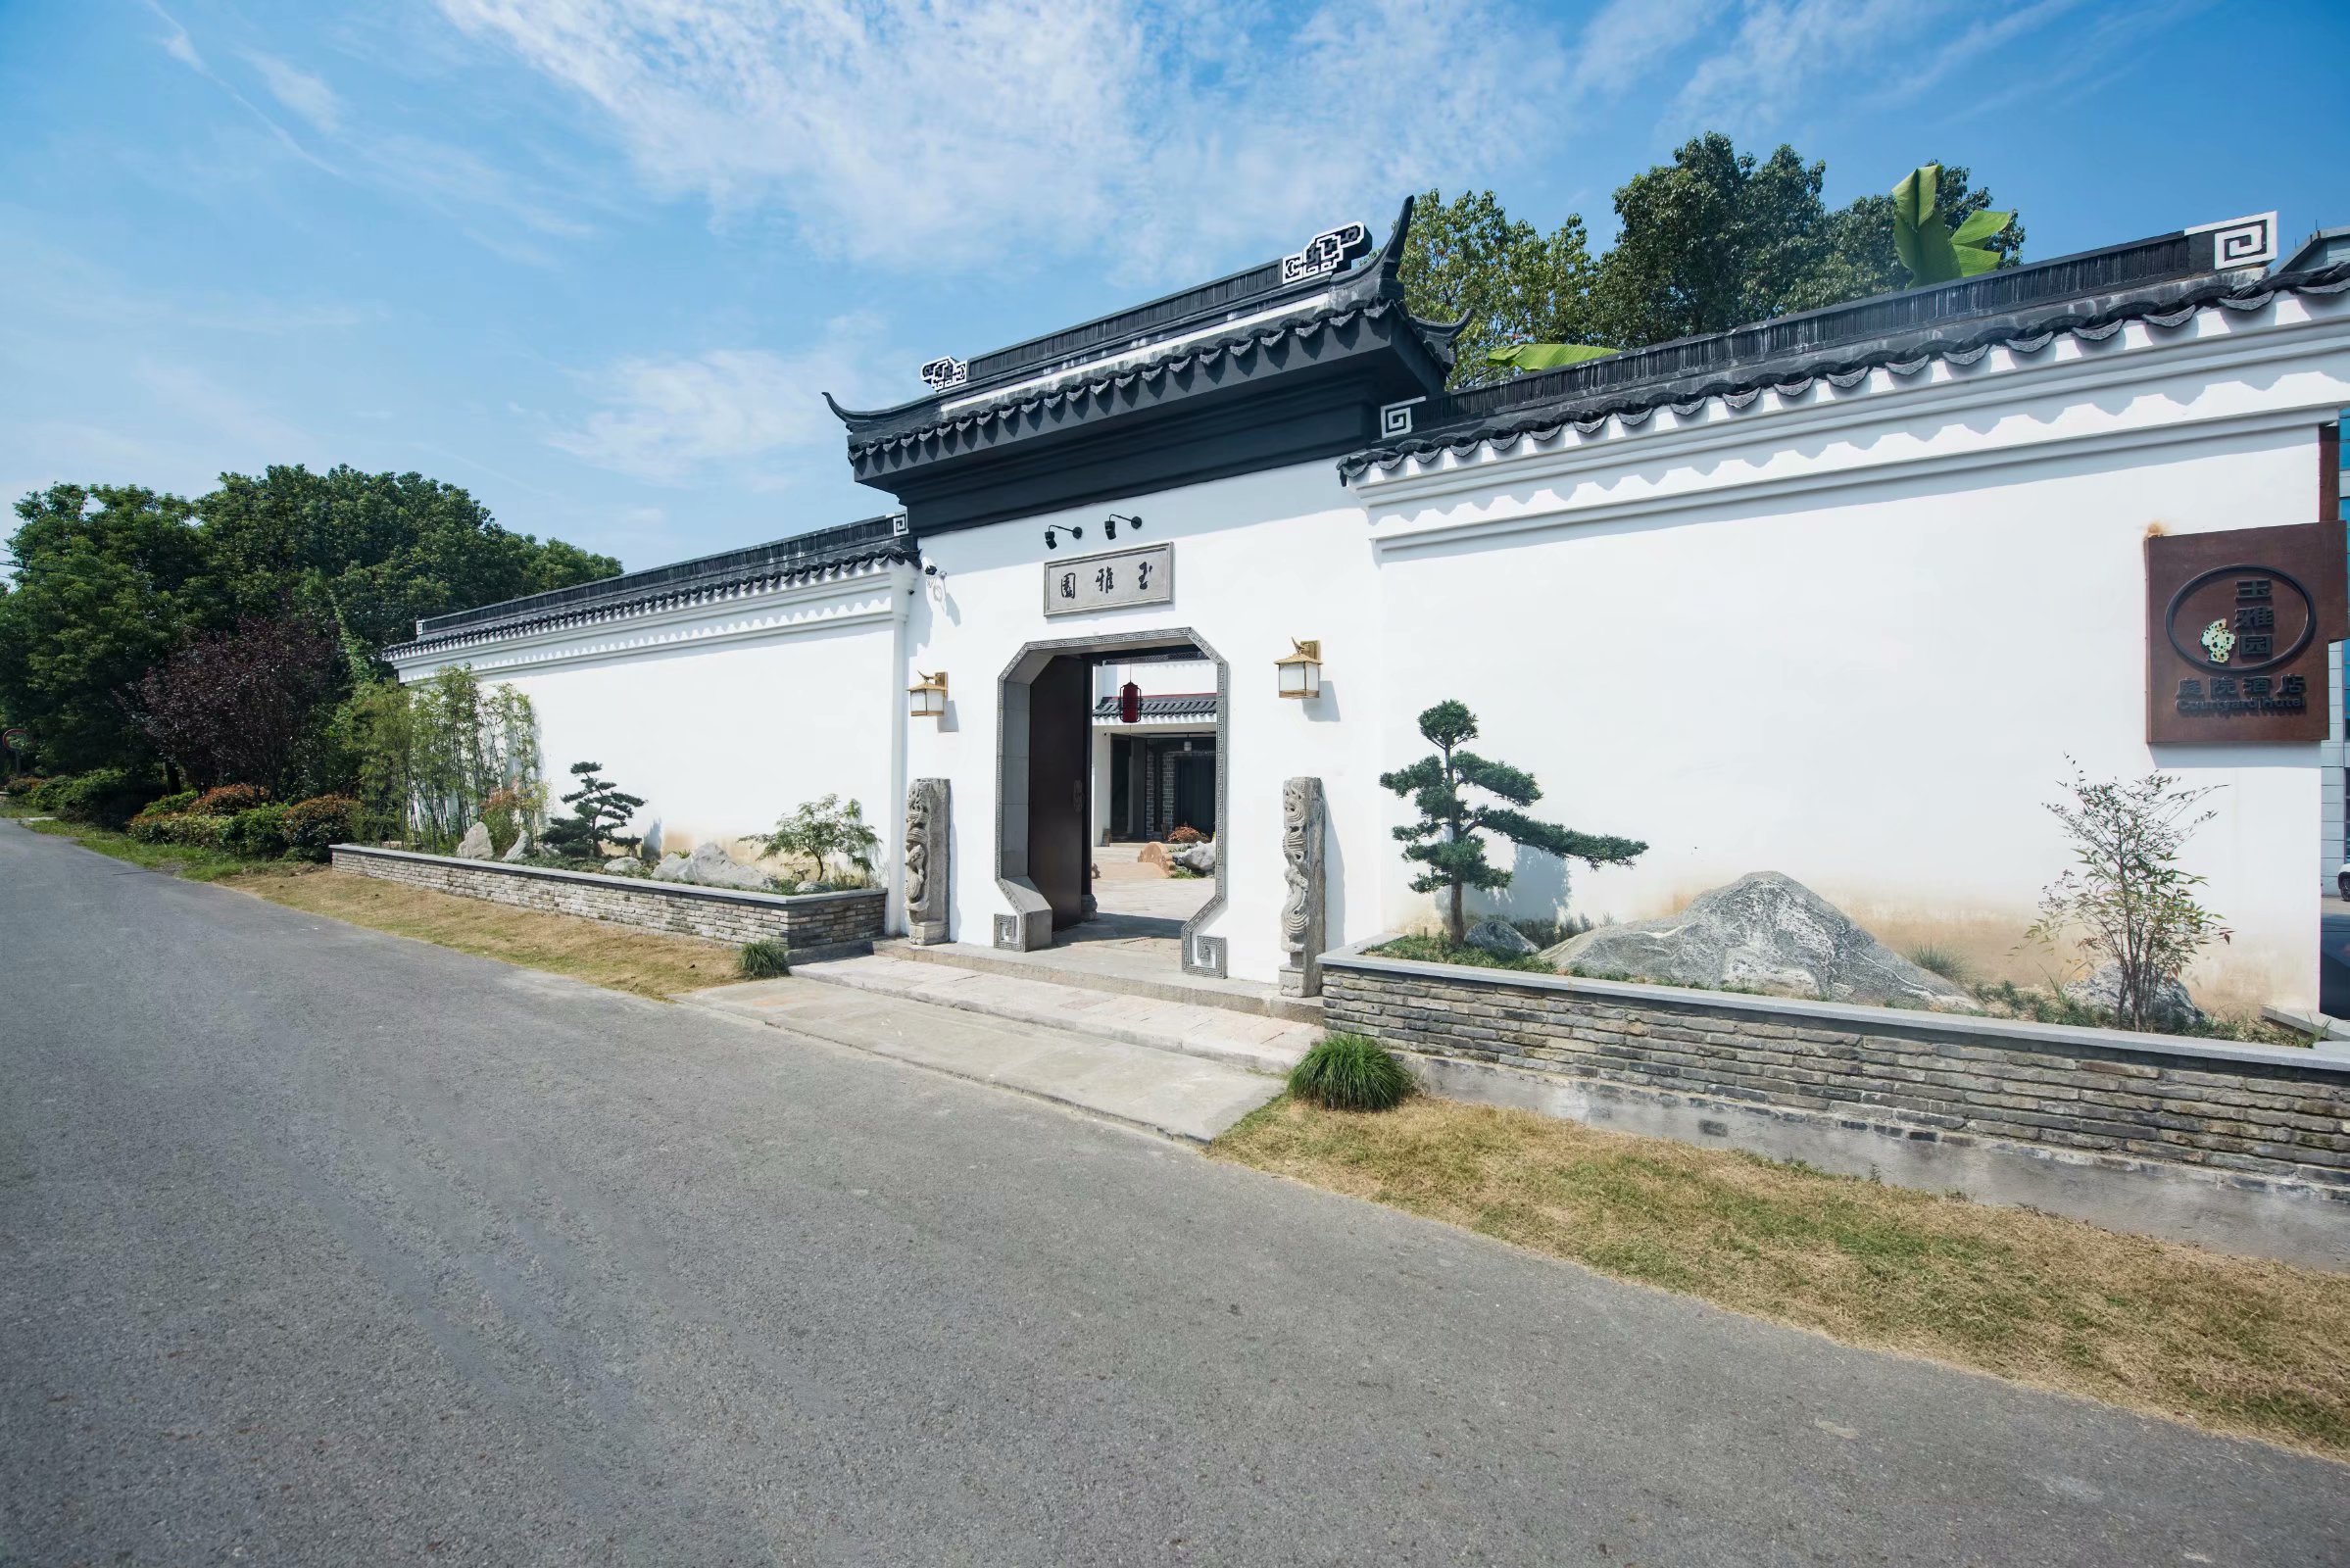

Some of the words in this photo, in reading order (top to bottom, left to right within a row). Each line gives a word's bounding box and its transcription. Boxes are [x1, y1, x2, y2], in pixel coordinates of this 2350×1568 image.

[2234, 578, 2274, 656] 玉雅园
[2176, 673, 2306, 696] 庭院酒店
[2176, 697, 2258, 712] Courtyard
[2259, 697, 2305, 709] Hotel
